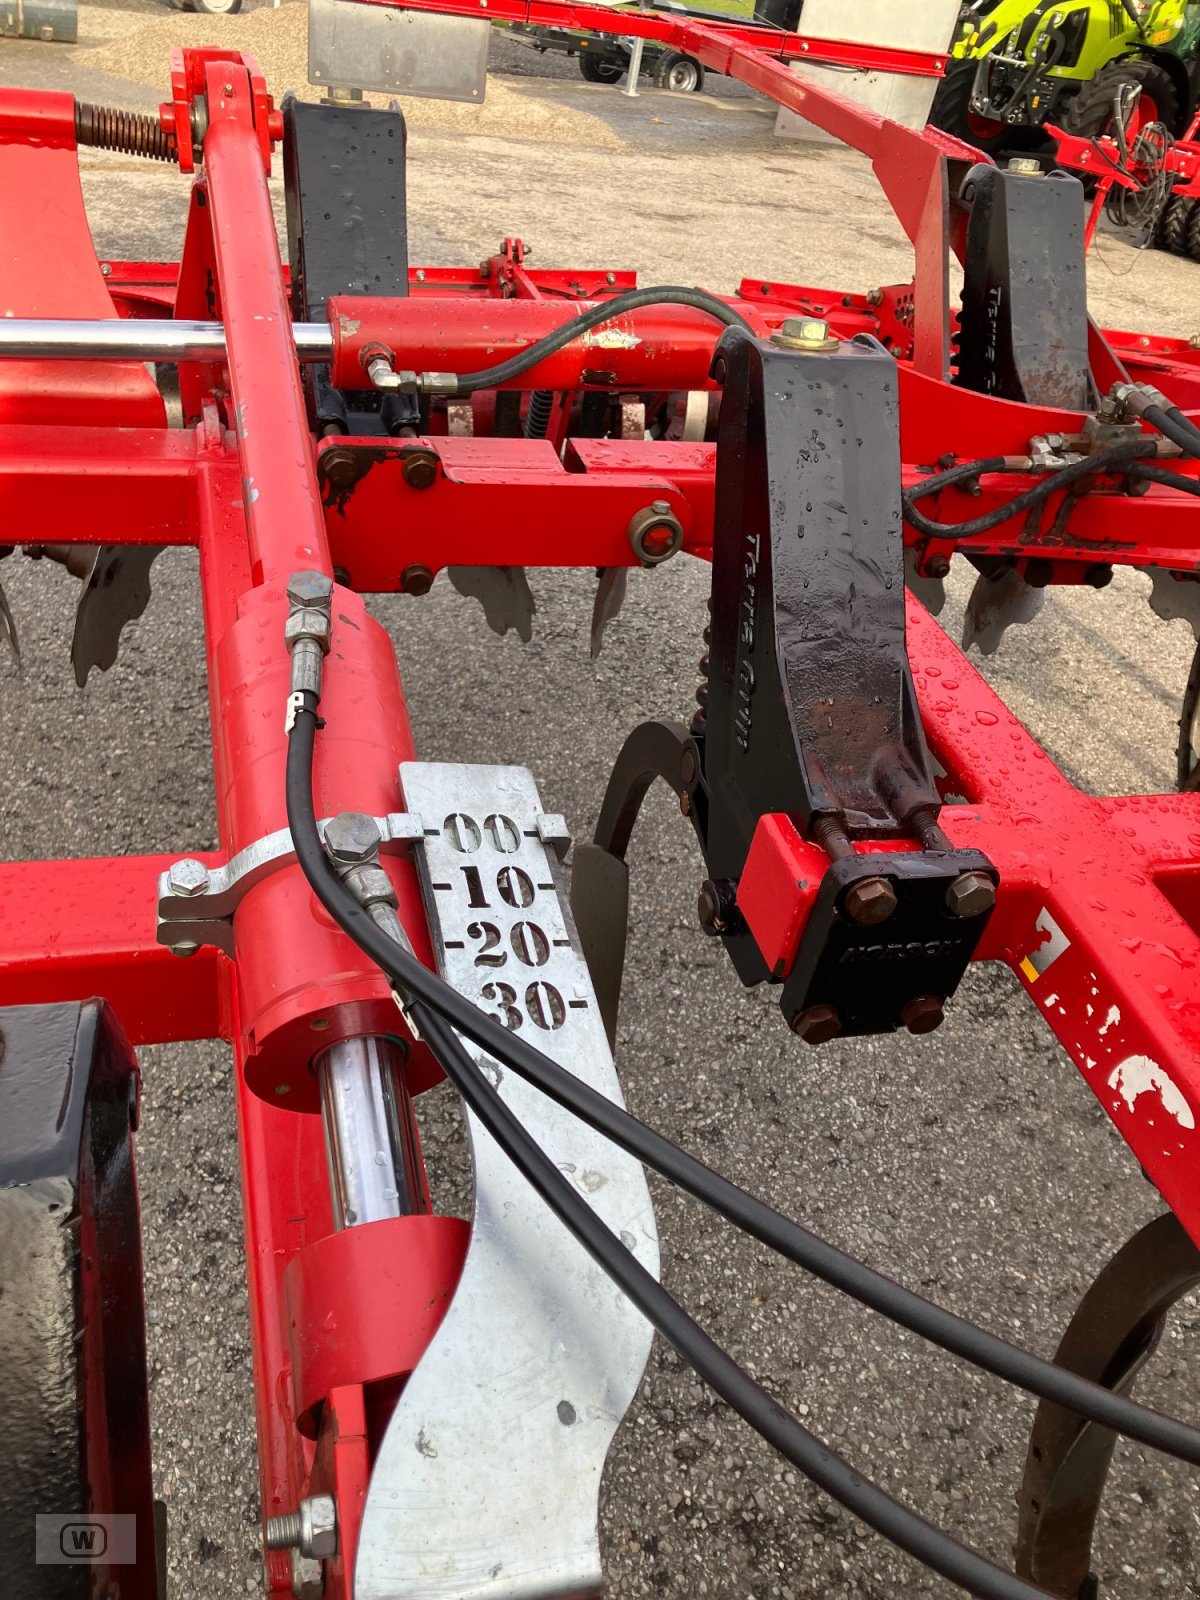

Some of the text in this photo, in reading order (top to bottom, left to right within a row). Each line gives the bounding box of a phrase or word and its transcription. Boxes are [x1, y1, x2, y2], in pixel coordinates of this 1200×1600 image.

[443, 812, 521, 853] 00
[459, 865, 535, 909] 10
[467, 920, 551, 967] 20
[480, 980, 566, 1031] 30
